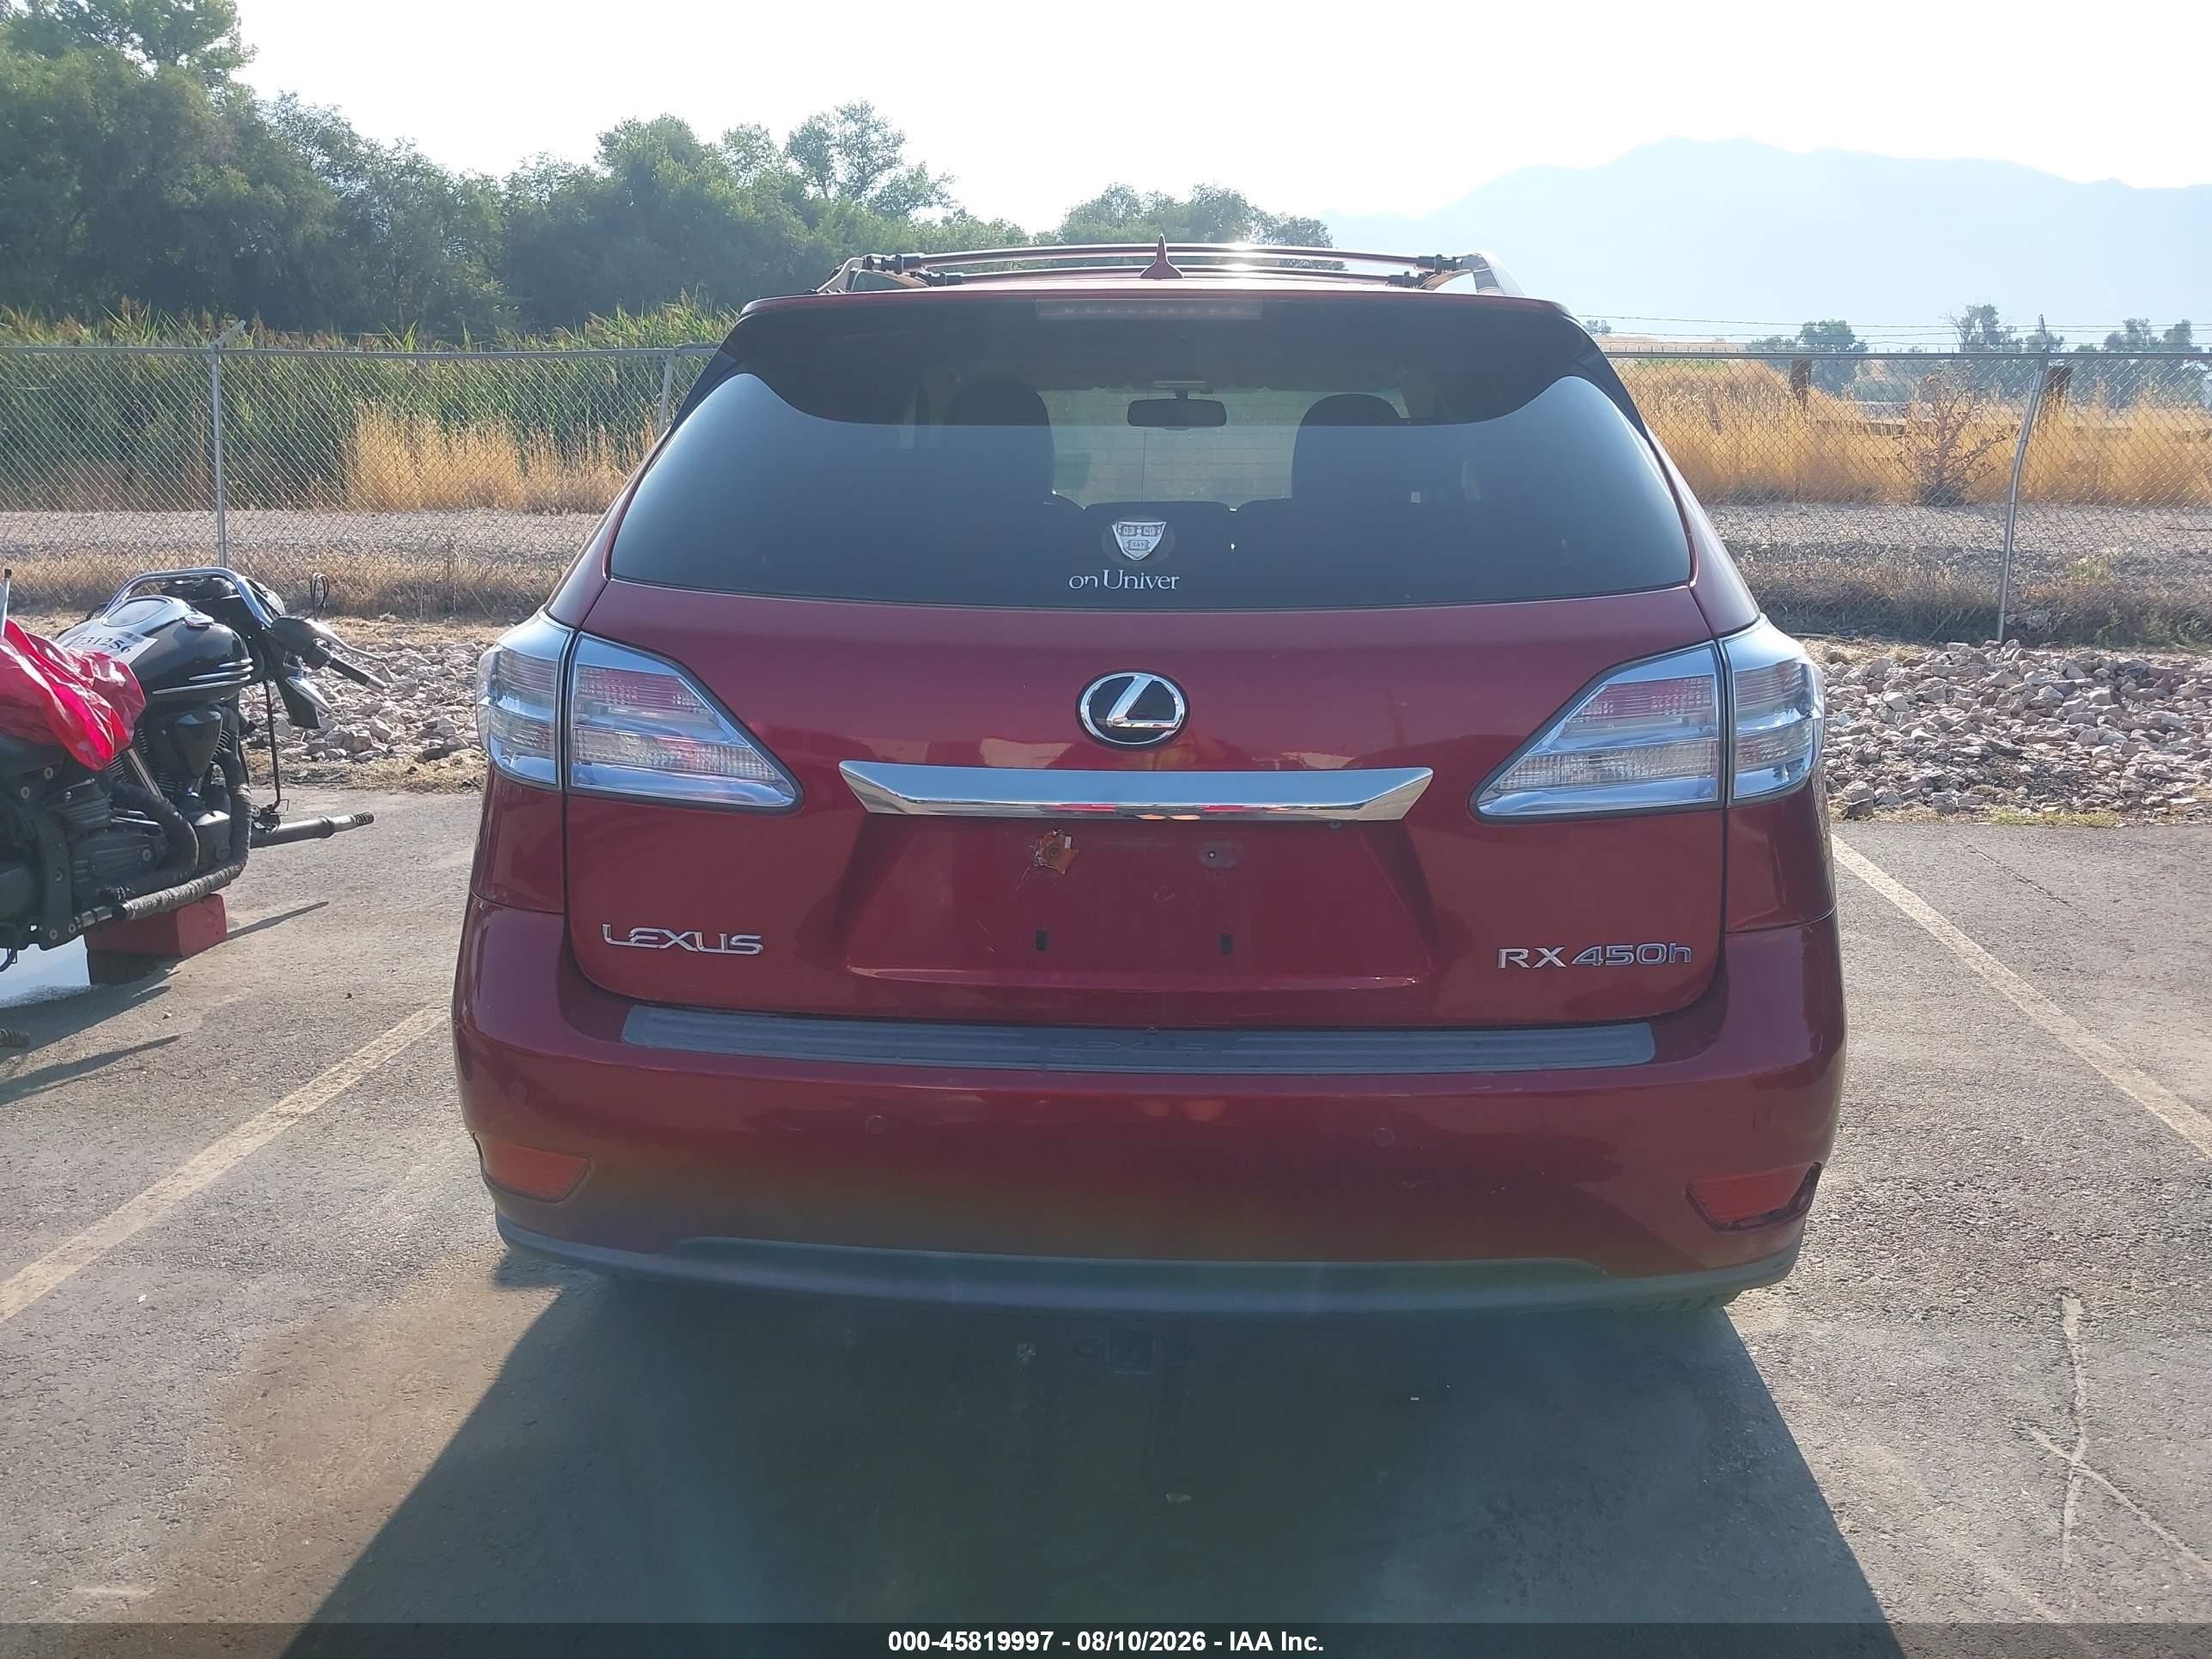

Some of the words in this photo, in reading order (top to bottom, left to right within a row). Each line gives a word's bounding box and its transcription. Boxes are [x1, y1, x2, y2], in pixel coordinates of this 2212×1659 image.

[1068, 574, 1098, 589] on
[1102, 569, 1180, 589] Univer
[601, 923, 764, 955] LEXUS
[1497, 946, 1567, 969] RX
[1571, 943, 1692, 967] 450h
